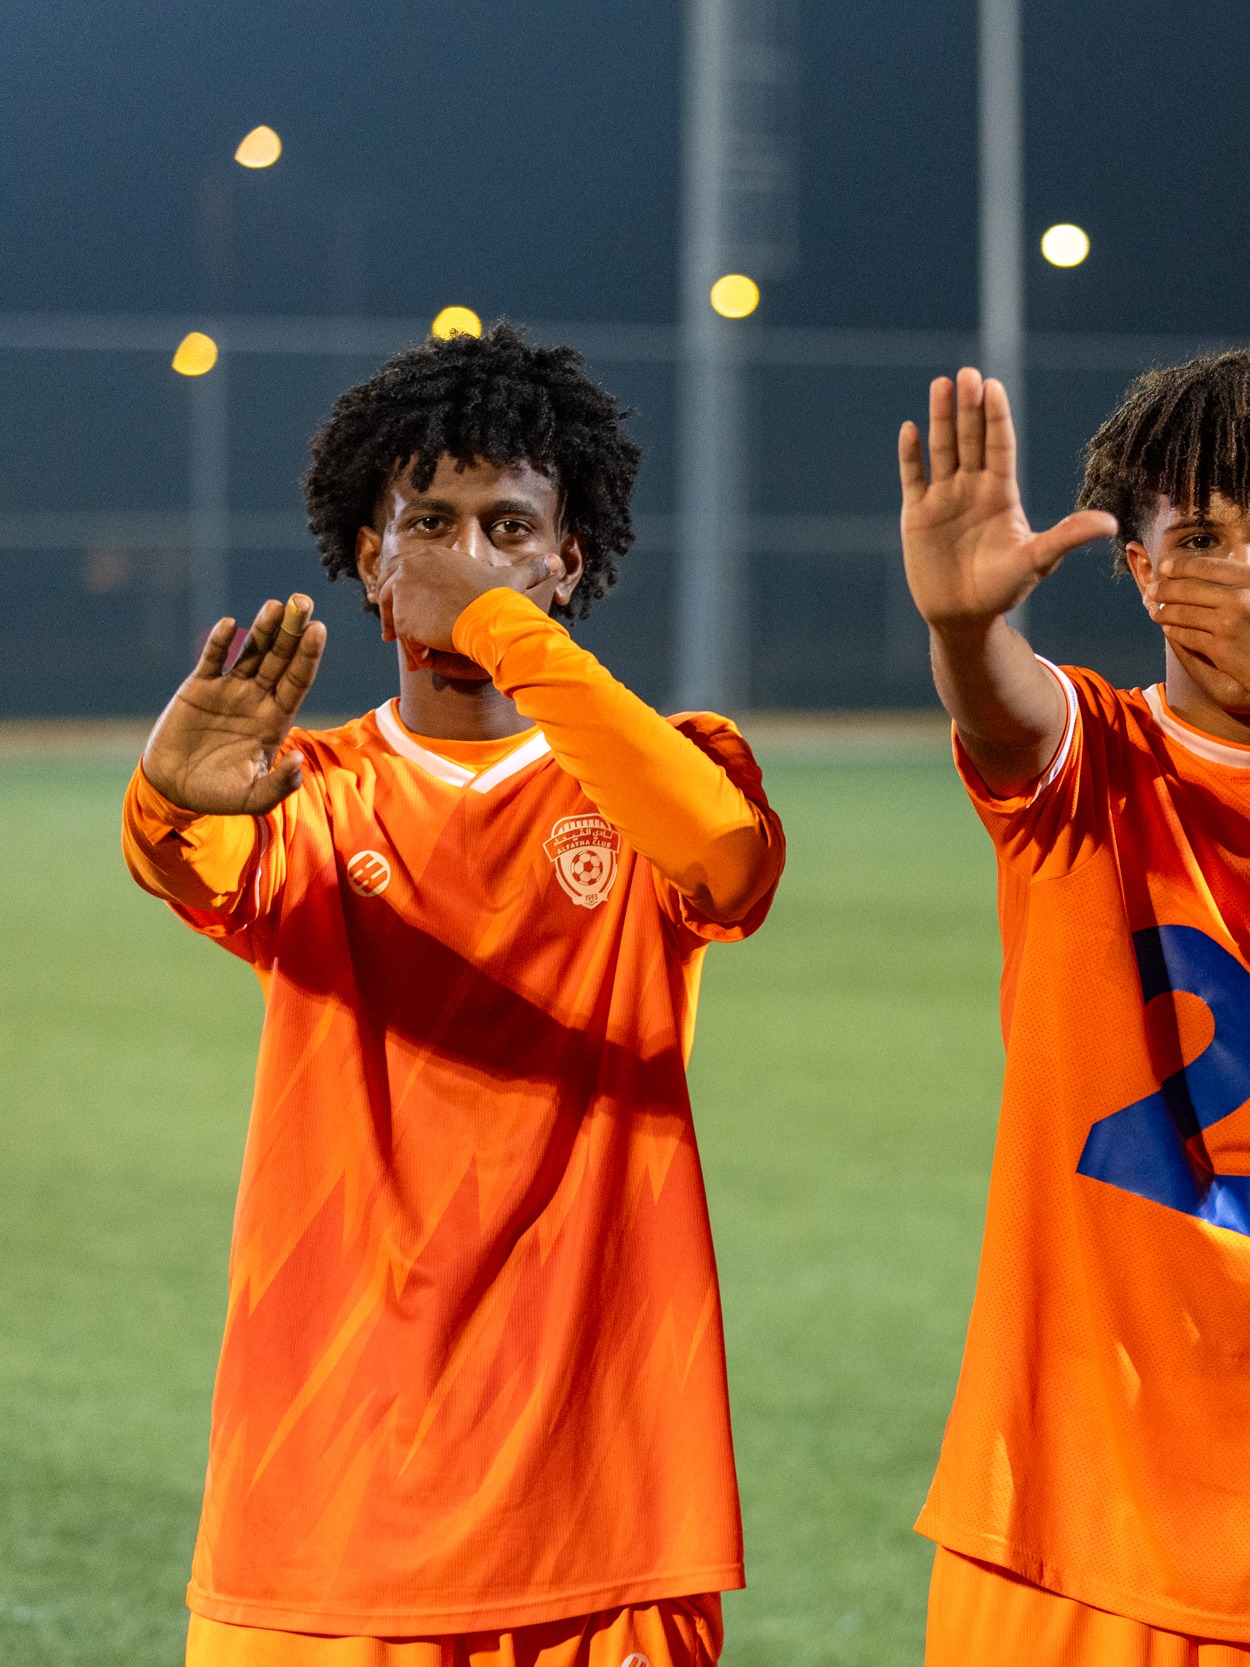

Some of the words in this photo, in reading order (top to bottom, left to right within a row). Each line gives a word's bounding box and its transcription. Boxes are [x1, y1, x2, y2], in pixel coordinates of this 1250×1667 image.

[554, 828, 591, 846] الفيحاء
[592, 830, 614, 840] نادي
[557, 840, 590, 855] ALFAYHA
[592, 839, 612, 849] CLUB
